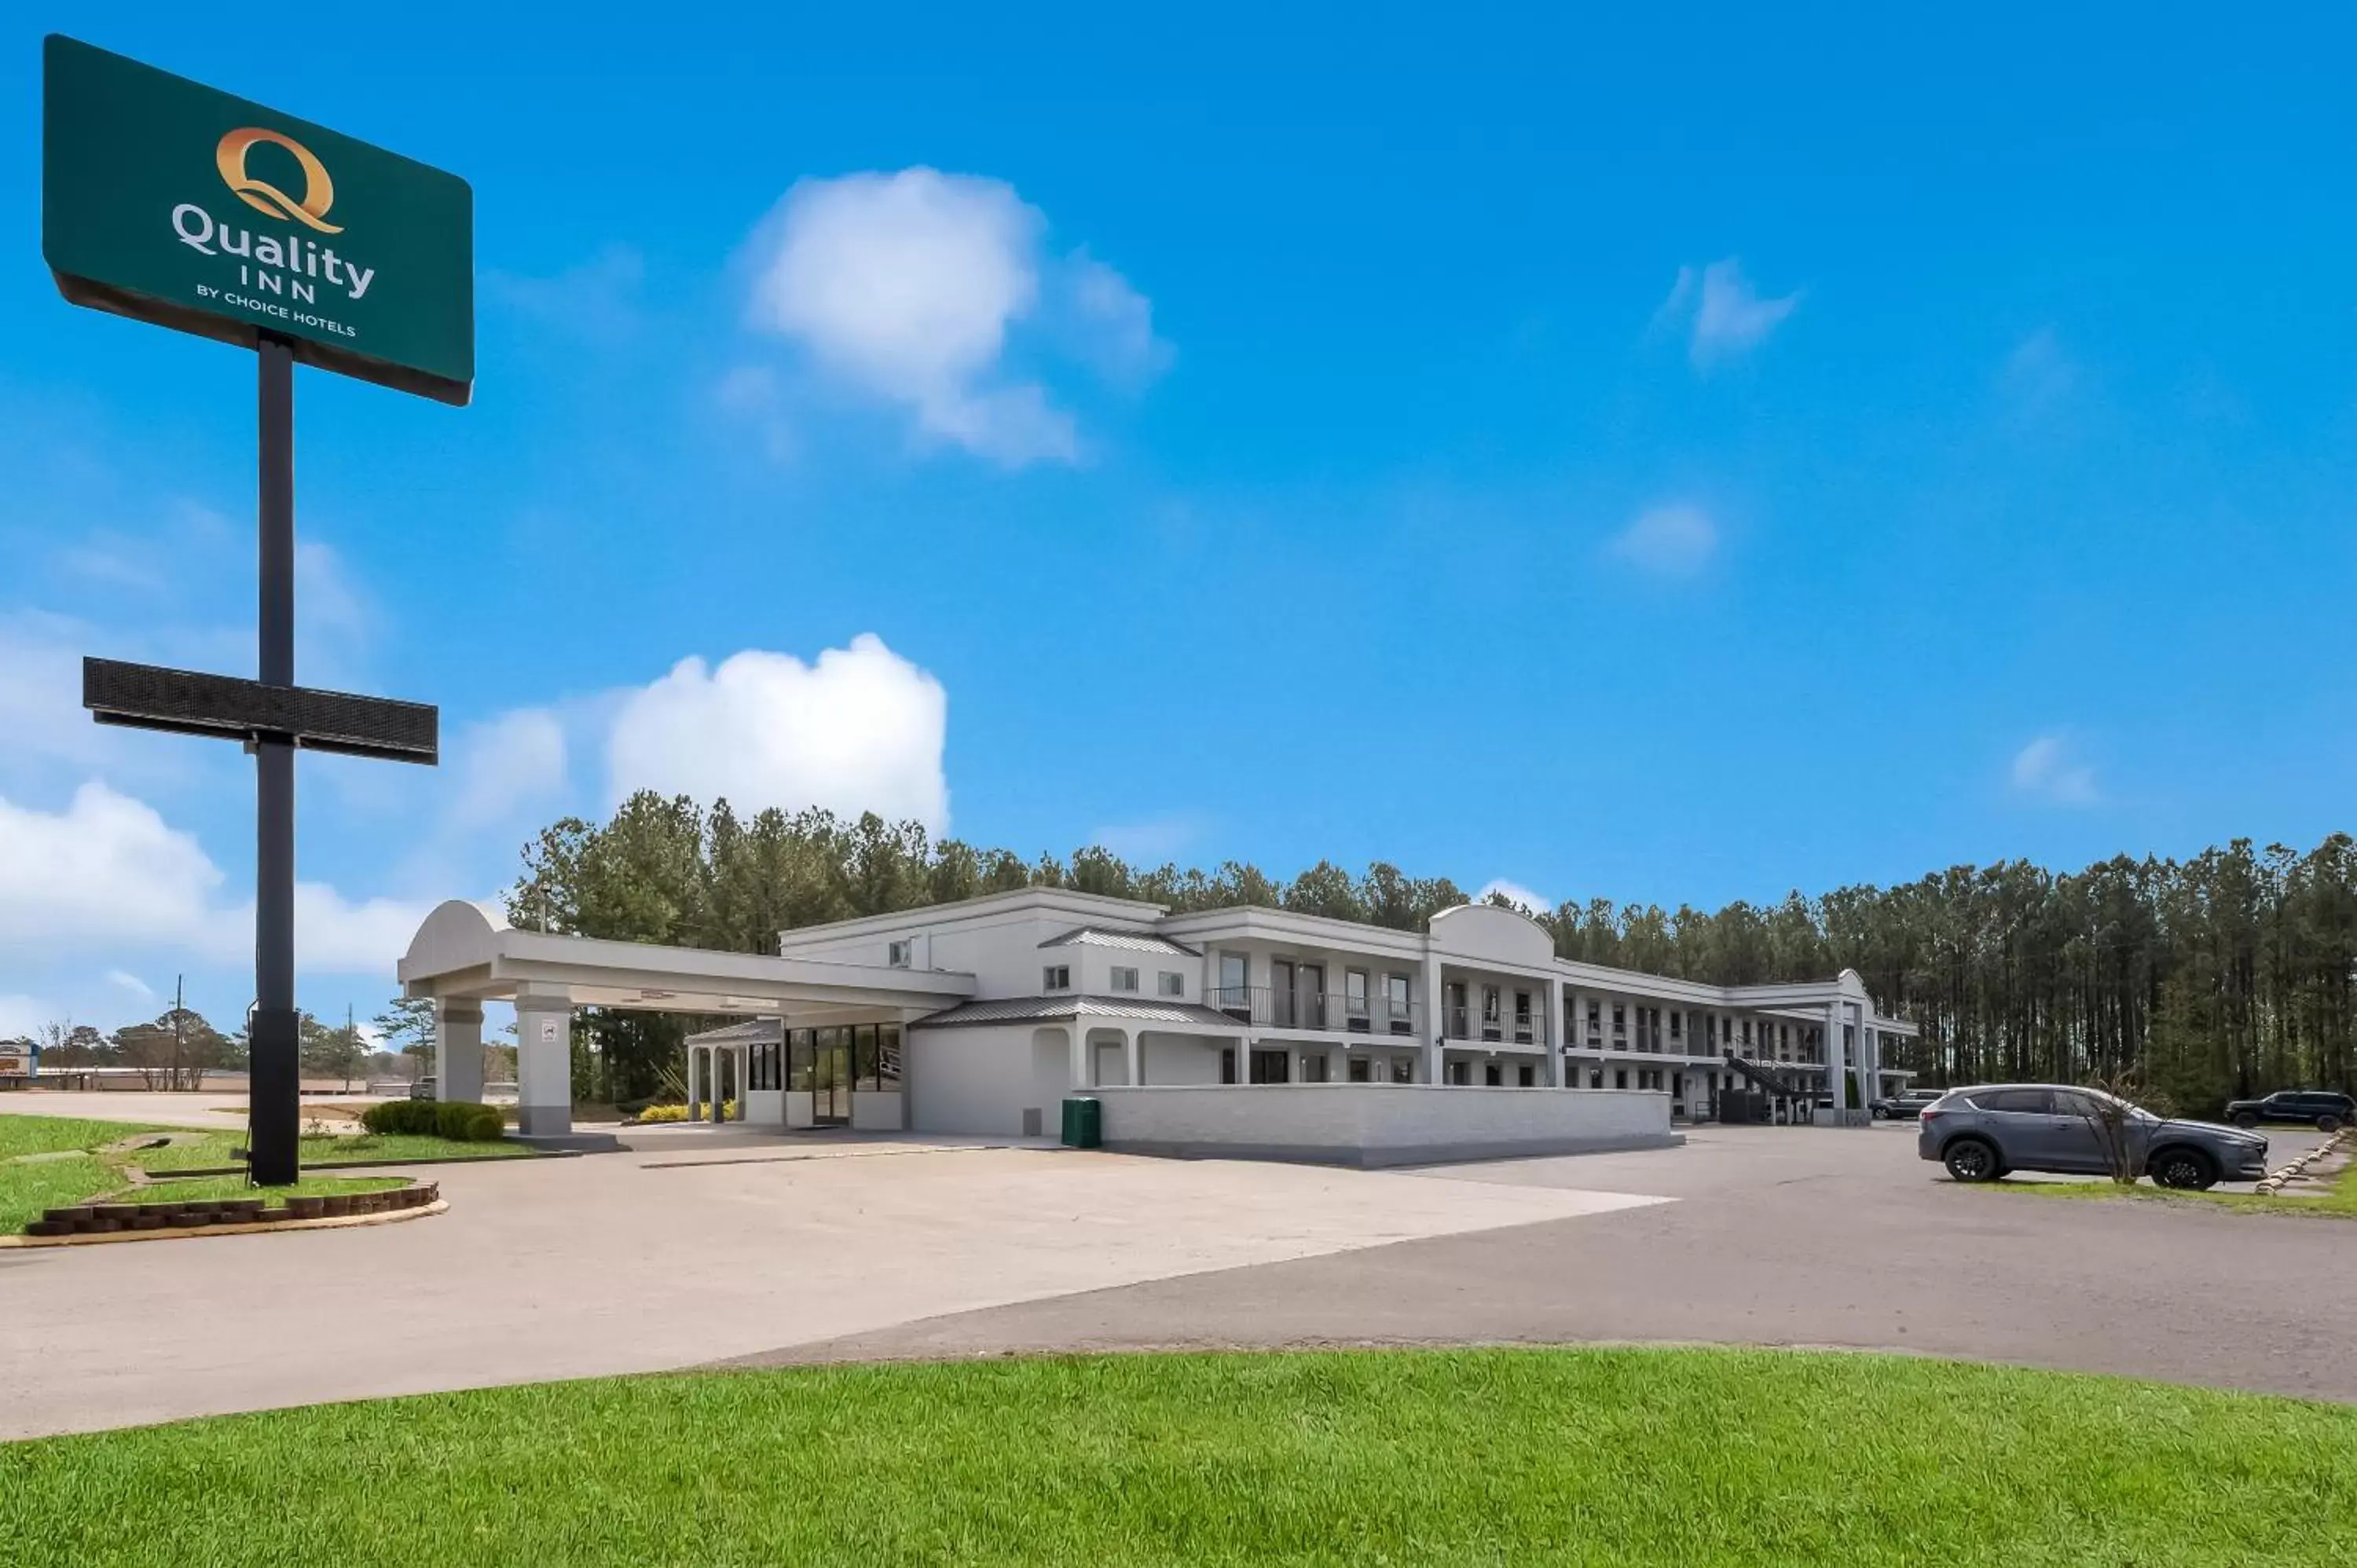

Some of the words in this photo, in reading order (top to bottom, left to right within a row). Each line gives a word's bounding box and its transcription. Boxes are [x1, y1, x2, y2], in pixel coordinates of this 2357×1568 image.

[216, 127, 345, 234] Q
[172, 203, 375, 299] Quality
[241, 265, 315, 305] INN
[196, 284, 219, 299] BY
[225, 292, 288, 319] CHOICE
[293, 311, 356, 337] HOTELS
